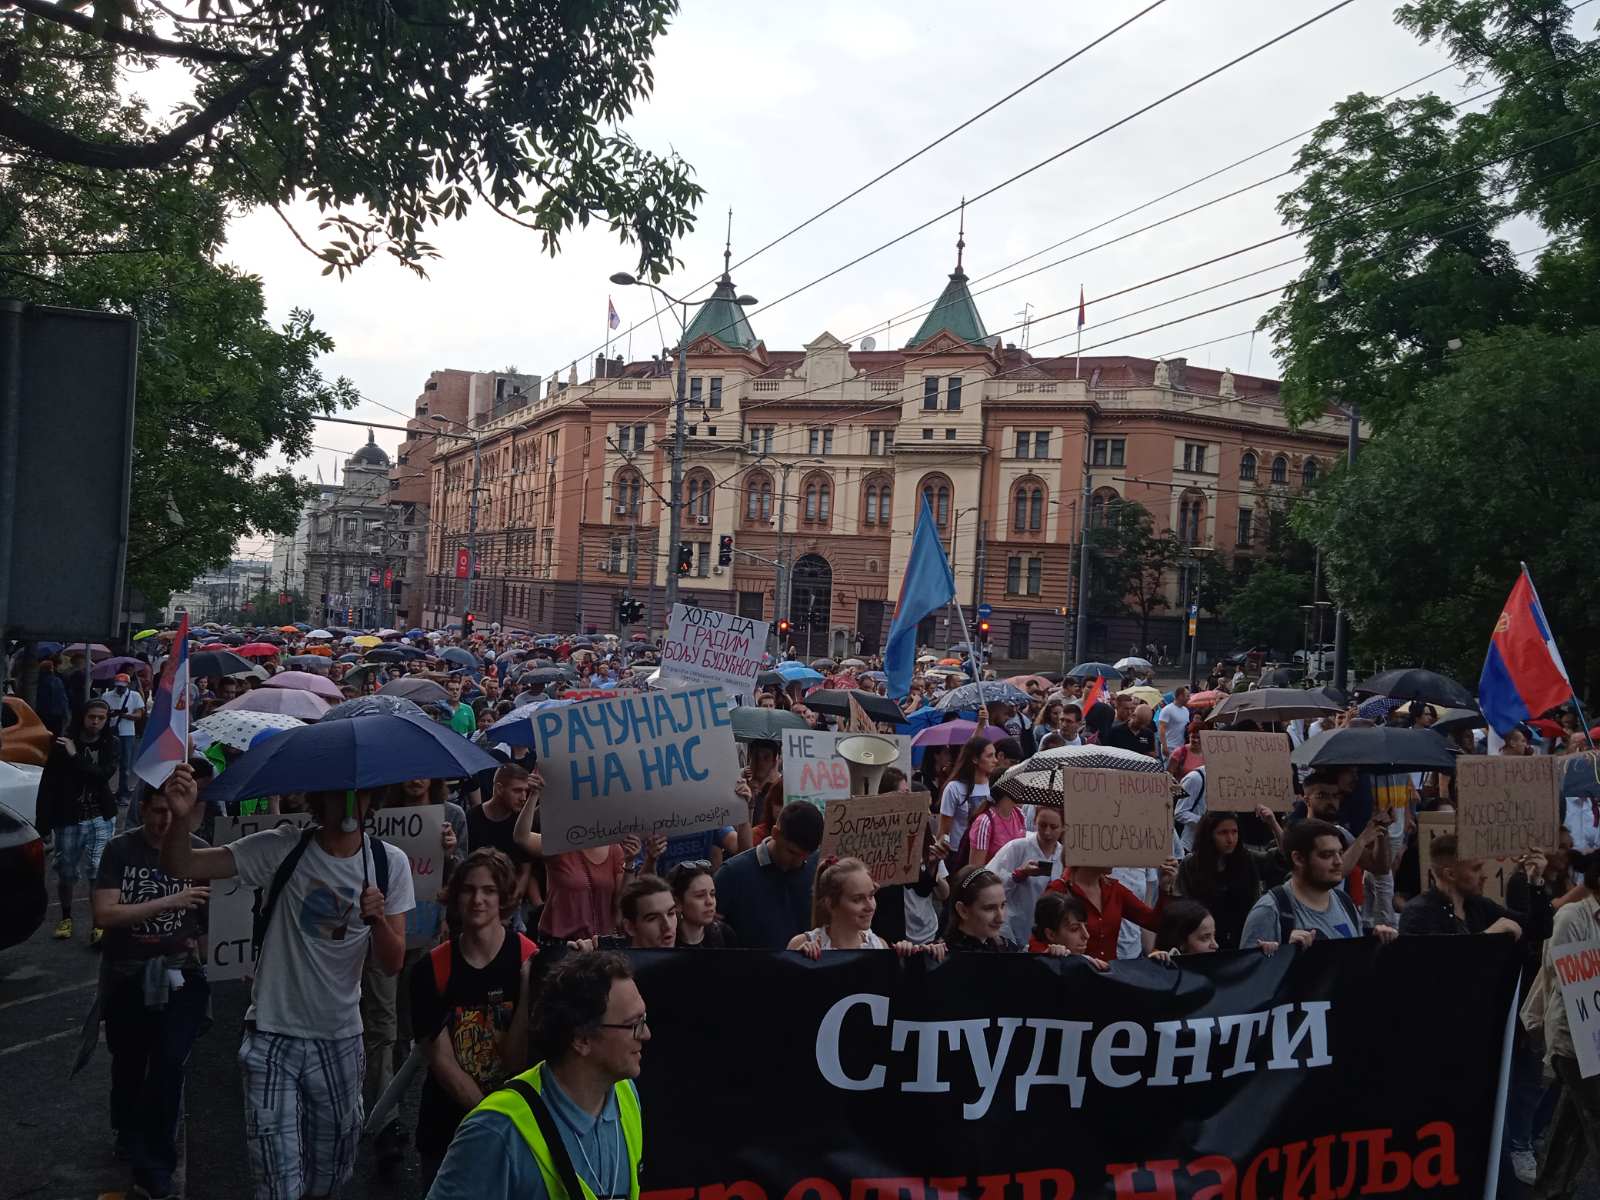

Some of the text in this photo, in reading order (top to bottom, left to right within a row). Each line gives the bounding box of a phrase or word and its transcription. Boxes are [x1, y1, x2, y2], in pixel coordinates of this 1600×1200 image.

[681, 605, 755, 640] ХОЋУ ДА
[664, 640, 700, 665] БОЉУ
[683, 623, 750, 656] ГРАДИМ
[536, 686, 731, 758] РАЧУНАЈТЕ
[788, 734, 815, 758] НЕ
[569, 751, 633, 801] НА
[639, 735, 710, 792] НАС
[1072, 771, 1168, 798] СТОП НАСИЉУ
[1112, 799, 1122, 818] У
[212, 938, 258, 967] СТ
[815, 992, 1334, 1120] Студенти
[1105, 1120, 1460, 1200] насиља
